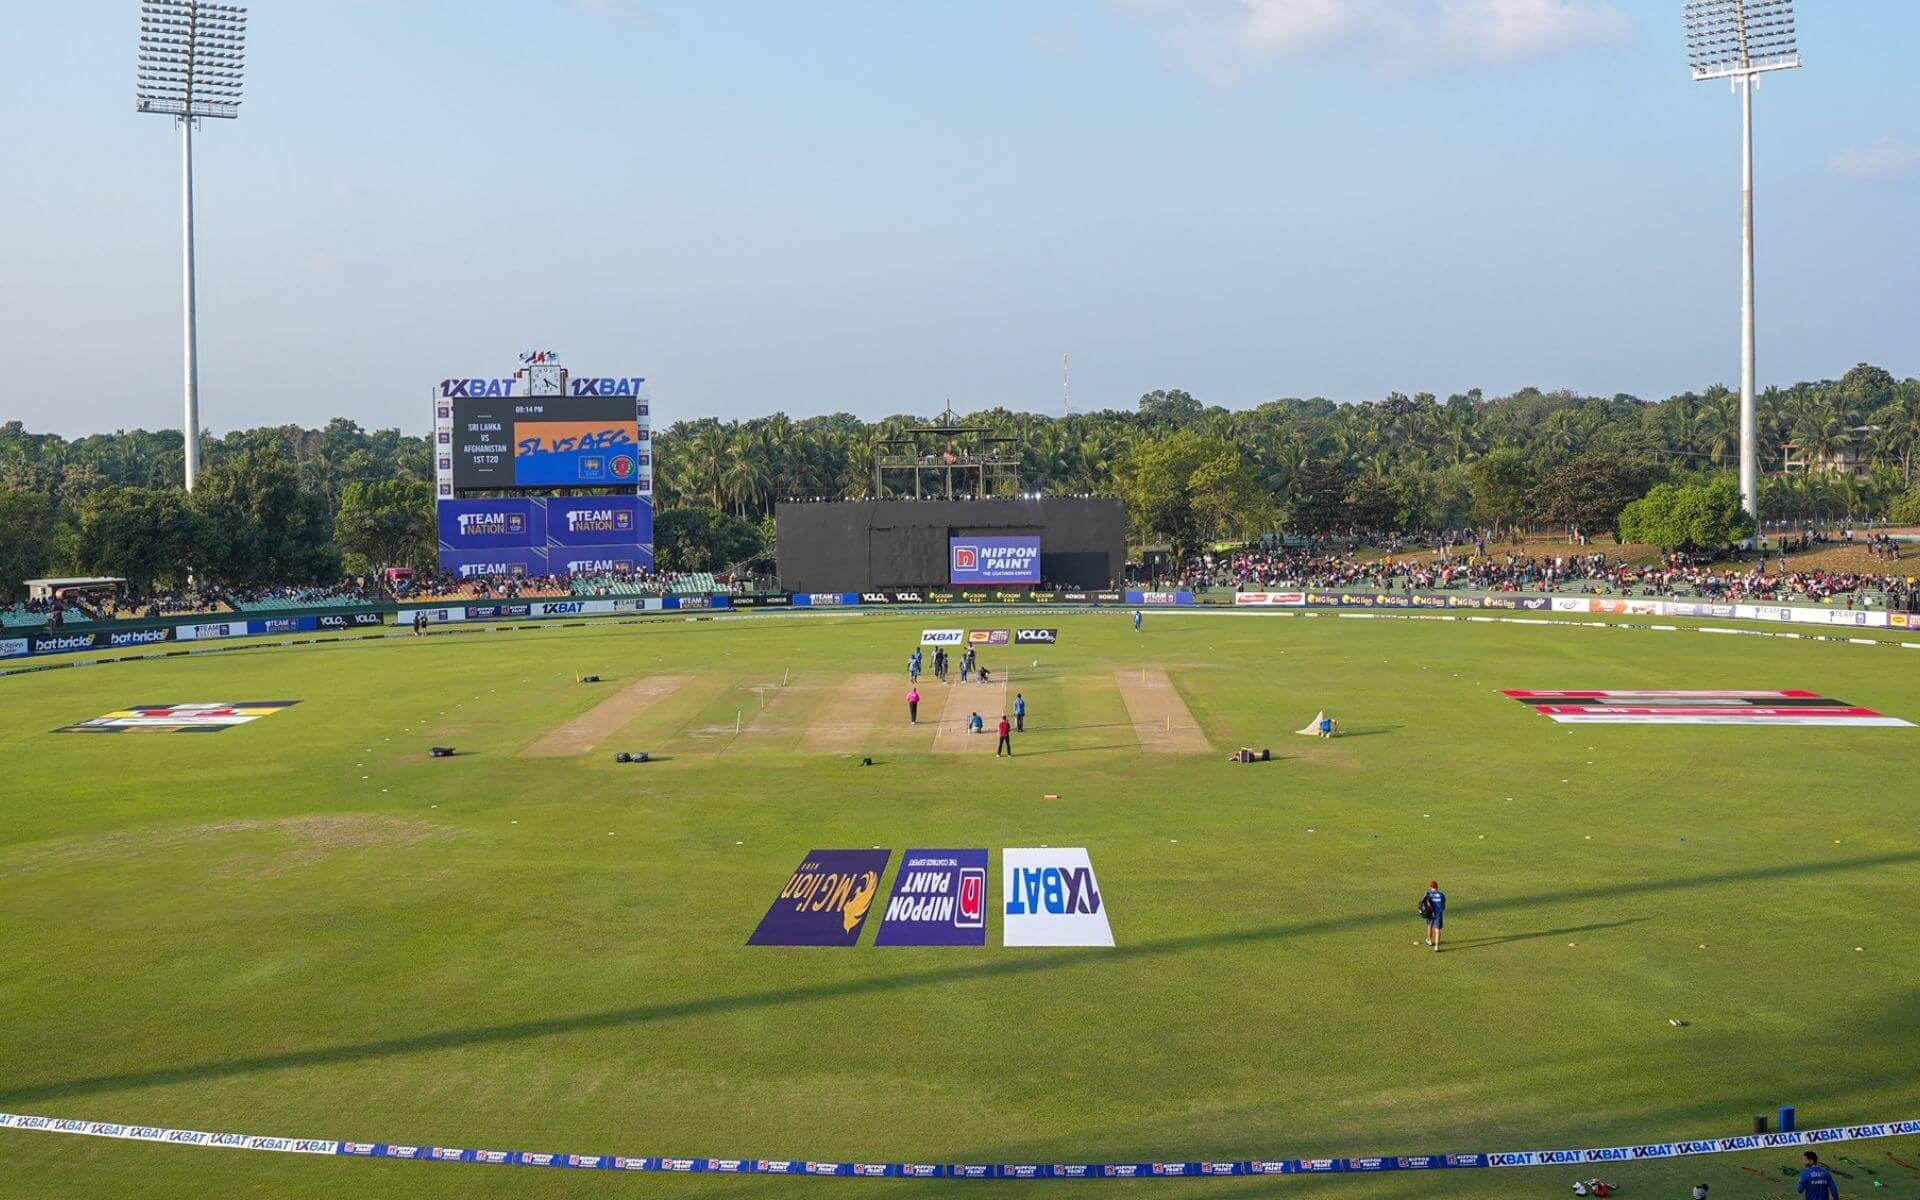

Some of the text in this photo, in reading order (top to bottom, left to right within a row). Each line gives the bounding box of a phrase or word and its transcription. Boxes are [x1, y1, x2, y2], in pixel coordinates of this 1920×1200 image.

[440, 379, 516, 397] 1XBAT
[571, 378, 645, 396] 1XBAT
[468, 513, 504, 524] TEAM
[576, 510, 612, 521] TEAM
[467, 524, 504, 534] NATION
[576, 522, 612, 531] NATION
[981, 547, 1037, 558] NIPPON
[470, 564, 506, 574] TEAM
[577, 560, 612, 571] TEAM
[987, 559, 1031, 569] PAINT
[862, 593, 884, 602] YOLO
[896, 593, 918, 601] YOLO
[542, 602, 584, 614] 1XBAT
[320, 616, 342, 625] YOLO
[355, 614, 376, 623] YOLO
[111, 633, 130, 644] bat
[924, 633, 961, 641] 1XBAT
[1017, 630, 1048, 640] YOLO
[36, 639, 56, 650] bat
[900, 872, 951, 893] PAINT
[1006, 867, 1100, 914] 1XBAT
[885, 896, 954, 921] NIPPON
[17, 1117, 51, 1129] 1XBAT
[54, 1120, 88, 1132] 1XBAT
[91, 1124, 127, 1136] 1XBAT
[130, 1126, 166, 1138] 1XBAT
[1806, 1129, 1844, 1142] 1XBAT
[1848, 1125, 1885, 1139] 1XBAT
[169, 1130, 207, 1143] 1XBAT
[210, 1133, 249, 1146] 1XBAT
[1764, 1133, 1801, 1146] 1XBAT
[252, 1138, 290, 1150] 1XBAT
[295, 1140, 335, 1152] 1XBAT
[1677, 1141, 1716, 1154] 1XBAT
[1721, 1136, 1761, 1150] 1XBAT
[1539, 1150, 1581, 1163] 1XBAT
[1586, 1148, 1628, 1161] 1XBAT
[1632, 1144, 1673, 1157] 1XBAT
[1490, 1152, 1533, 1166] 1XBAT
